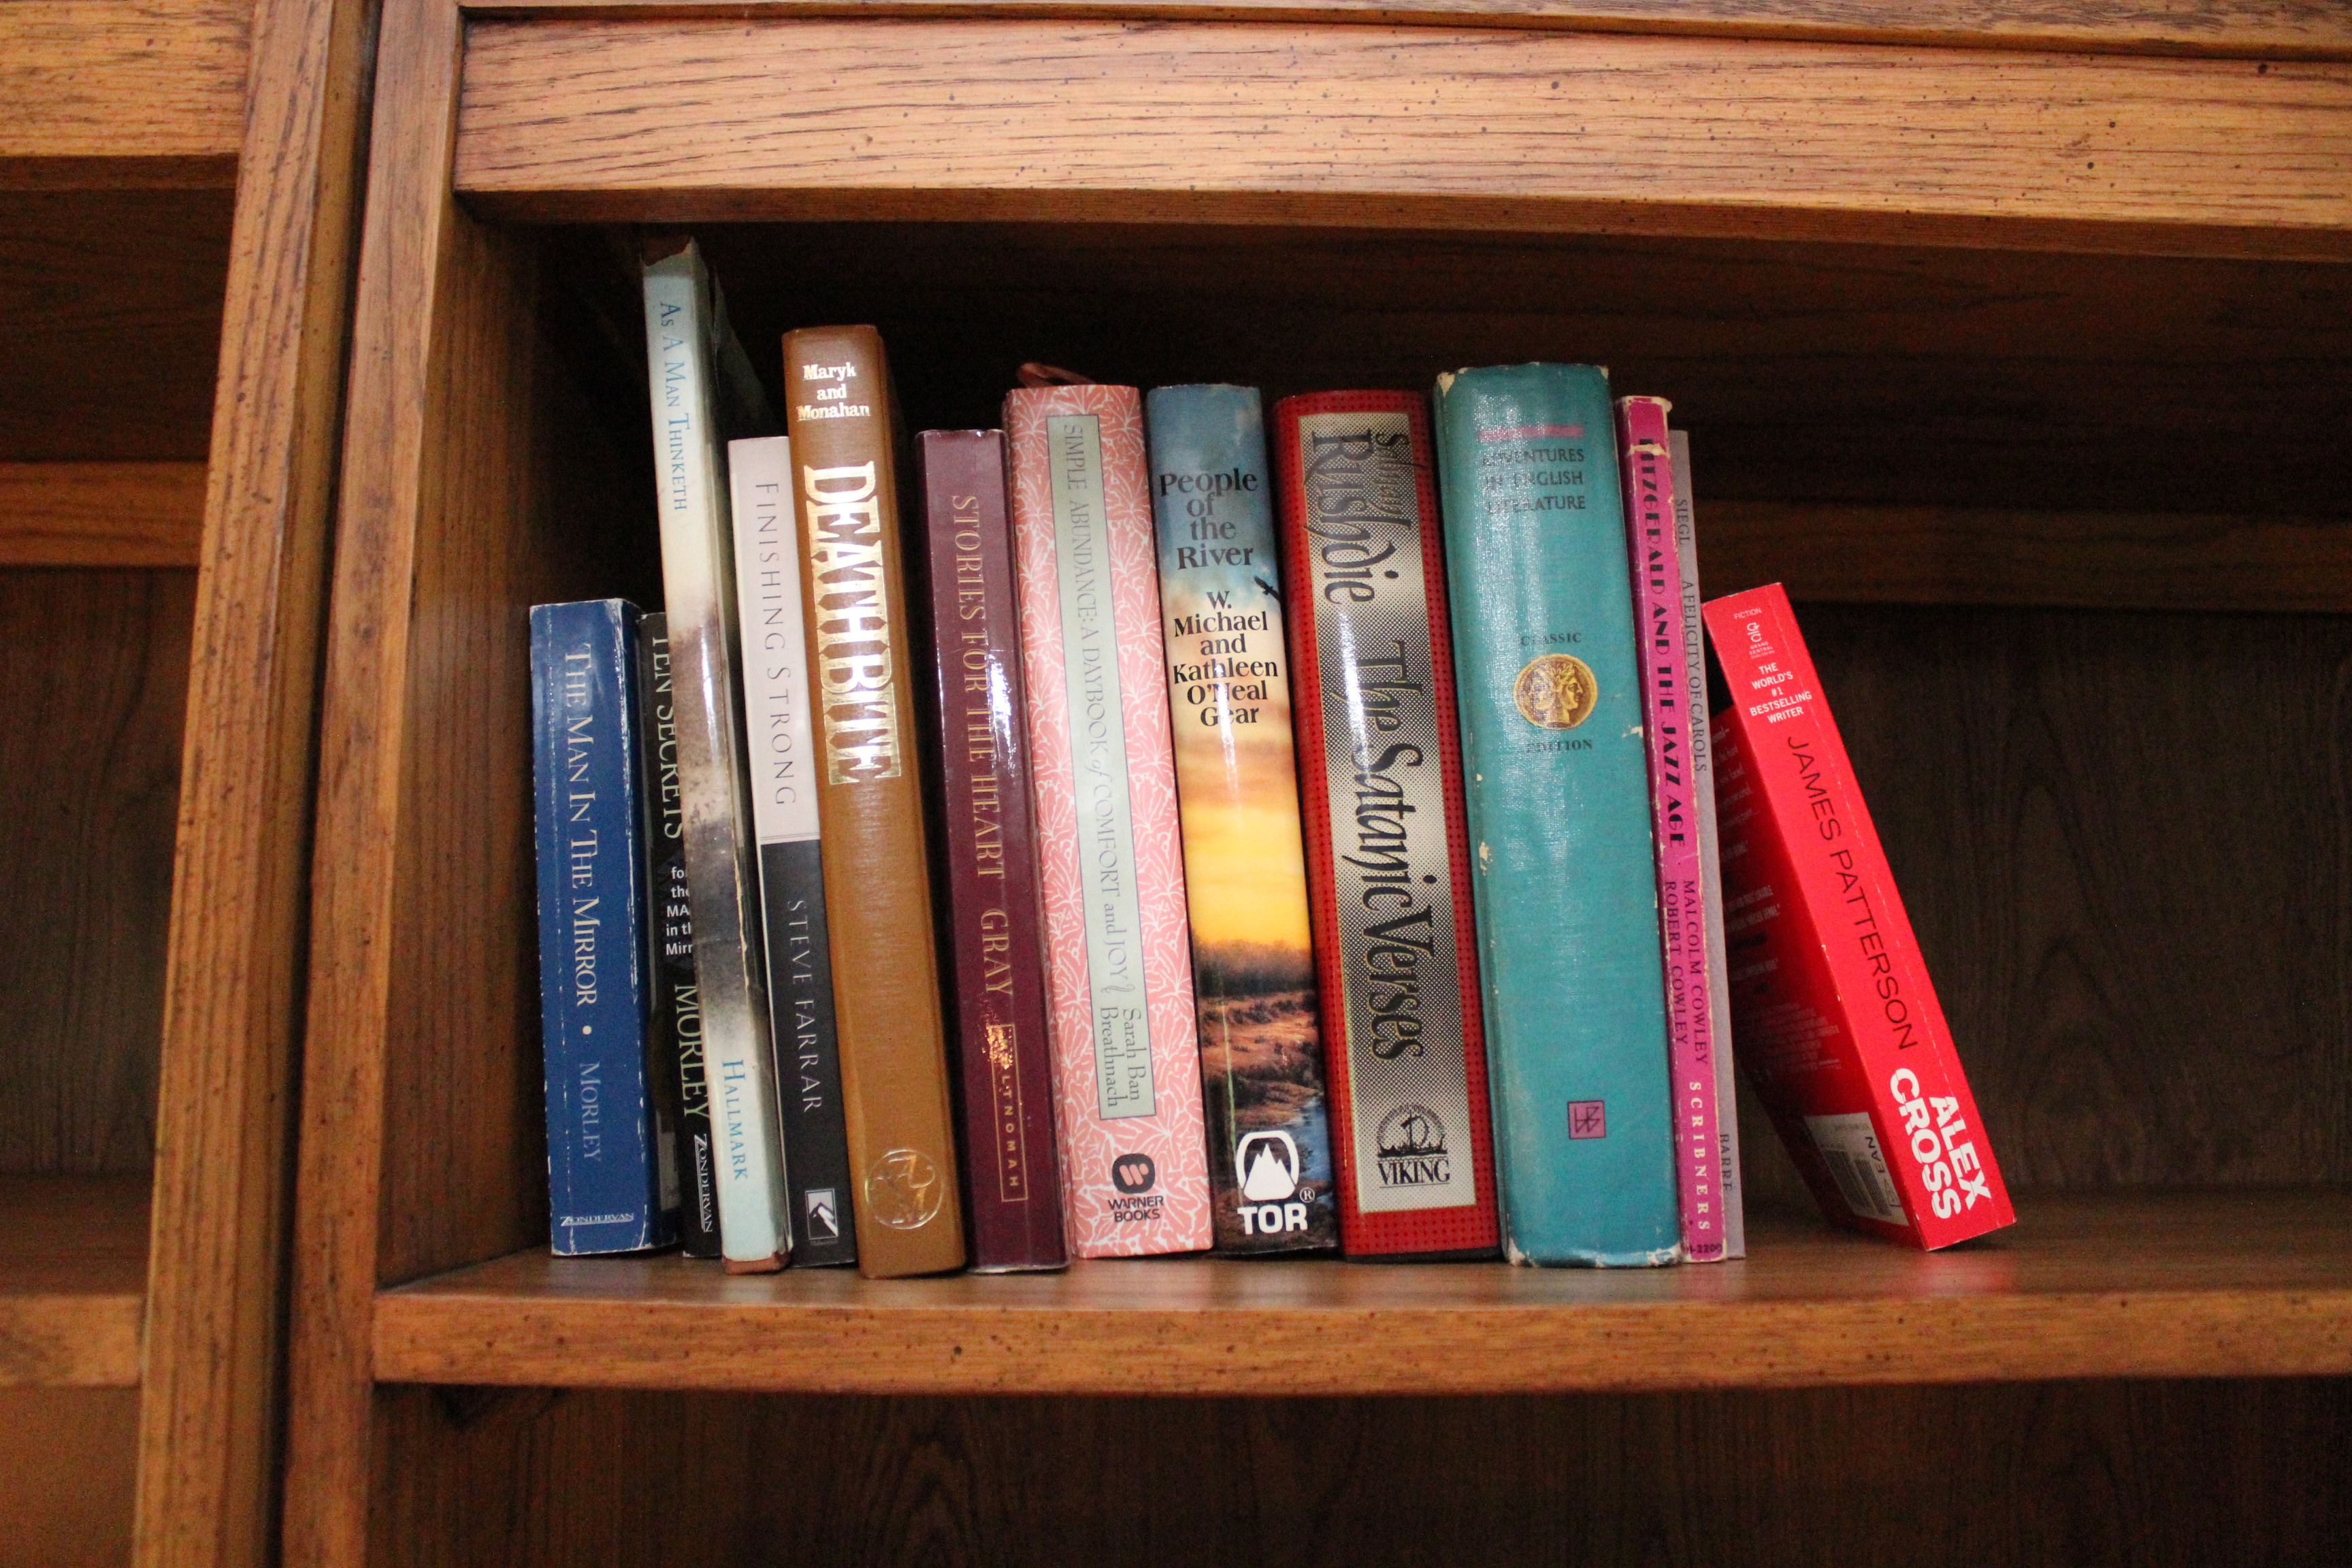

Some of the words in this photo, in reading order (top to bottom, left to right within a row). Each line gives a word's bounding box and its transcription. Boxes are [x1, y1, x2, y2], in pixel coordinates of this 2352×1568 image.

[663, 337, 685, 352] A
[802, 362, 857, 381] Maryk
[665, 361, 687, 408] MAN
[817, 384, 847, 400] and
[796, 402, 871, 422] Monahan
[669, 412, 690, 511] THINKETH
[1063, 424, 1088, 491] SIMPLE
[1159, 468, 1258, 497] People
[1186, 491, 1215, 517] of
[1190, 517, 1237, 541] the
[1303, 429, 1412, 605] Rushdie
[1676, 499, 1690, 545] SIEGL
[755, 483, 785, 651] FINISHING
[953, 495, 985, 621] STORIES
[1070, 498, 1098, 623] ABUNDANCE:
[1177, 542, 1254, 570] River
[1206, 590, 1232, 610] W.
[1682, 581, 1695, 591] A
[1080, 625, 1100, 640] A
[1174, 610, 1269, 638] Michael
[1652, 602, 1670, 656] AND
[1684, 594, 1701, 671] FELICITY
[1734, 608, 1762, 619] FICTION
[961, 631, 990, 693] FOR
[1173, 657, 1279, 685] Kathleen
[1200, 633, 1247, 656] and
[1749, 646, 1774, 655] CENTRAL
[1750, 641, 1769, 649] GRAND
[1759, 662, 1779, 674] THE
[565, 644, 591, 707] THE
[1082, 647, 1110, 755] DAYBOOK
[1187, 680, 1268, 706] O'Neal
[1330, 639, 1423, 734] The
[1656, 666, 1676, 715] THE
[1689, 676, 1702, 699] OF
[1752, 671, 1793, 689] WORLD'S
[1771, 687, 1784, 697] #1
[1749, 691, 1812, 717] BESTSELLING
[1767, 706, 1803, 723] WRITER
[567, 716, 594, 782] MAN
[767, 667, 796, 805] STRONG
[966, 707, 997, 764] THE
[1661, 721, 1682, 787] JAZZ
[1690, 703, 1708, 772] CAROLS
[1085, 757, 1114, 782] of
[569, 791, 596, 822] IN
[970, 774, 1007, 879] HEART
[1341, 742, 1437, 912] Satanic
[1665, 794, 1685, 848] AGE
[571, 829, 598, 889] THE
[1093, 783, 1122, 898] COMFORT
[671, 866, 685, 879] fo
[1788, 736, 1842, 840] JAMES
[1829, 849, 1918, 1050] PATTERSON
[666, 924, 678, 936] in
[667, 904, 690, 917] MA
[1104, 903, 1126, 935] and
[1665, 881, 1682, 956] ROBERT
[1683, 880, 1702, 975] MALCOLM
[573, 897, 598, 1007] MIRROR
[787, 899, 814, 985] STEVE
[980, 908, 1014, 996] GRAY
[1104, 936, 1129, 983] JOY
[1362, 904, 1435, 1063] Verses
[1671, 966, 1688, 1045] COWLEY
[674, 984, 710, 1118] MORLEY
[1122, 1007, 1146, 1058] Sarah
[1691, 985, 1708, 1065] COWLEY
[795, 998, 823, 1113] FARRAR
[1100, 1006, 1128, 1109] Breathnach
[1128, 1064, 1147, 1102] Ban
[580, 1061, 601, 1162] MORLEY
[722, 1059, 748, 1181] HALLMARK
[1000, 1036, 1019, 1188] MLTNOMAH
[1690, 1081, 1710, 1230] SCRIBNERS
[1890, 1068, 1962, 1219] CROSS
[1929, 1096, 1991, 1210] ALEX
[693, 1133, 713, 1233] ZONDERVAN
[1377, 1159, 1450, 1185] VIKING
[1107, 1196, 1164, 1210] WARNER
[1114, 1209, 1160, 1222] BOOKS
[1237, 1203, 1308, 1235] TOR
